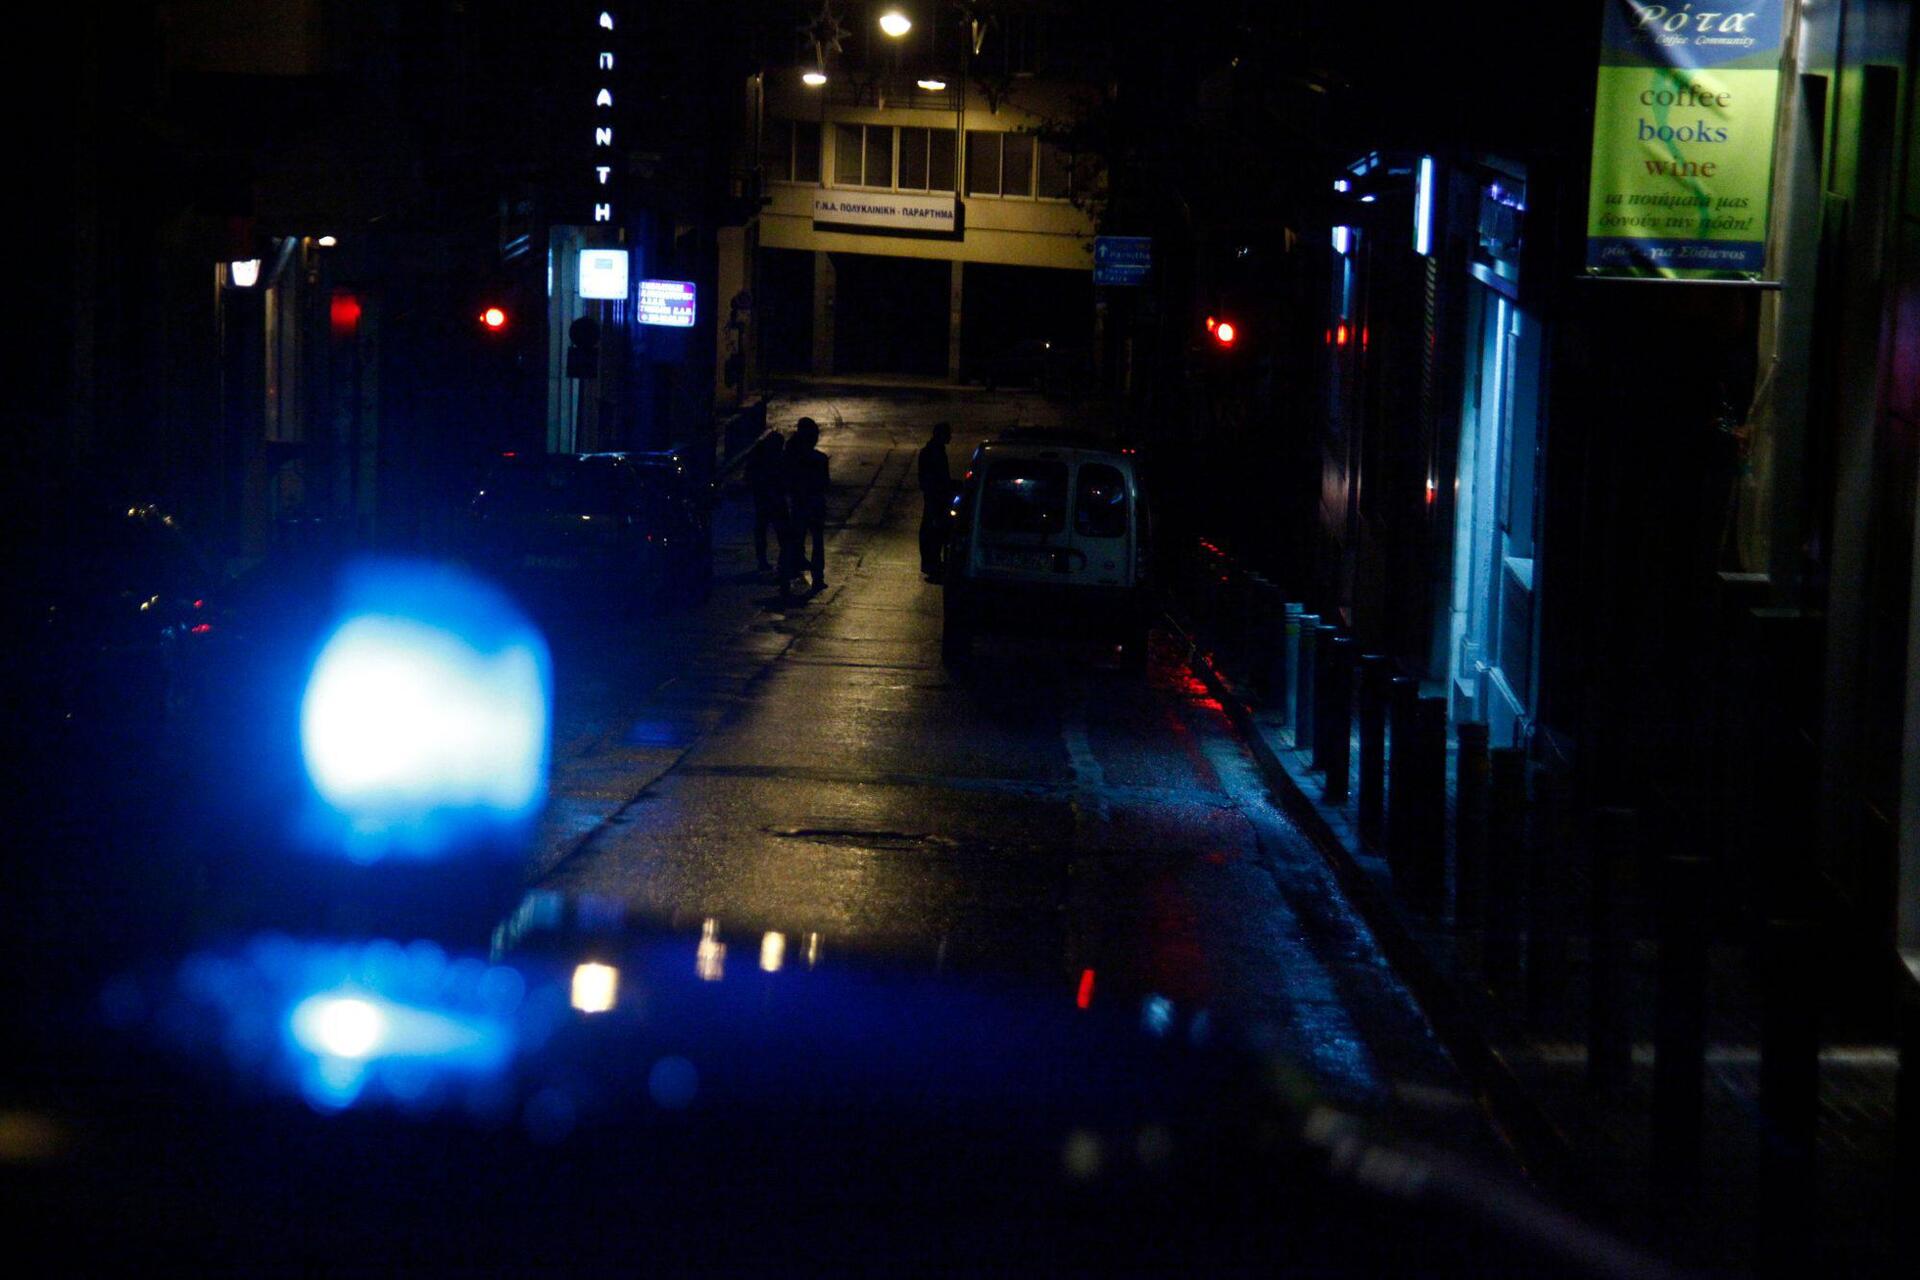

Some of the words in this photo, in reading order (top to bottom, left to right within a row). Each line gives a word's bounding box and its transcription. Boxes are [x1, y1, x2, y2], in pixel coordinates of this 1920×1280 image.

[1655, 35, 1688, 46] Coffee
[1696, 36, 1755, 47] Community
[1640, 84, 1730, 108] coffee
[1637, 119, 1728, 142] books
[1645, 156, 1716, 177] wine
[840, 203, 895, 215] ΠΟΛΥΚΛΙΝΙΚΗ
[902, 207, 953, 219] ΠΑΡΑΡΤΗΜΑ
